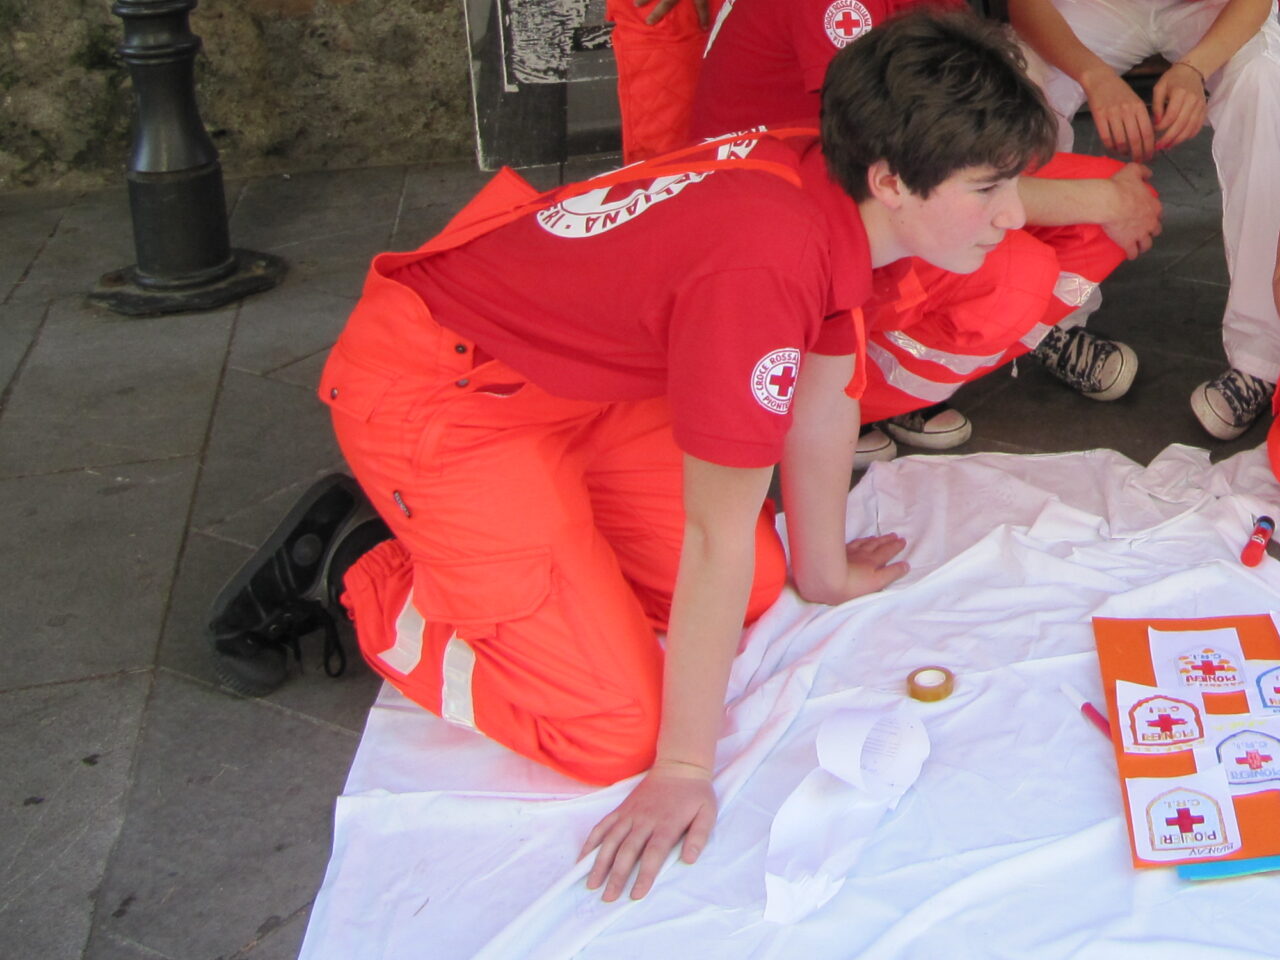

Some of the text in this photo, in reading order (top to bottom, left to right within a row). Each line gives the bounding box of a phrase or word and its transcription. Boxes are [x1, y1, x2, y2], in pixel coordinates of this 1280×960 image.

[756, 353, 797, 390] CROCE ROSSA
[1160, 830, 1217, 844] PIONIERI
